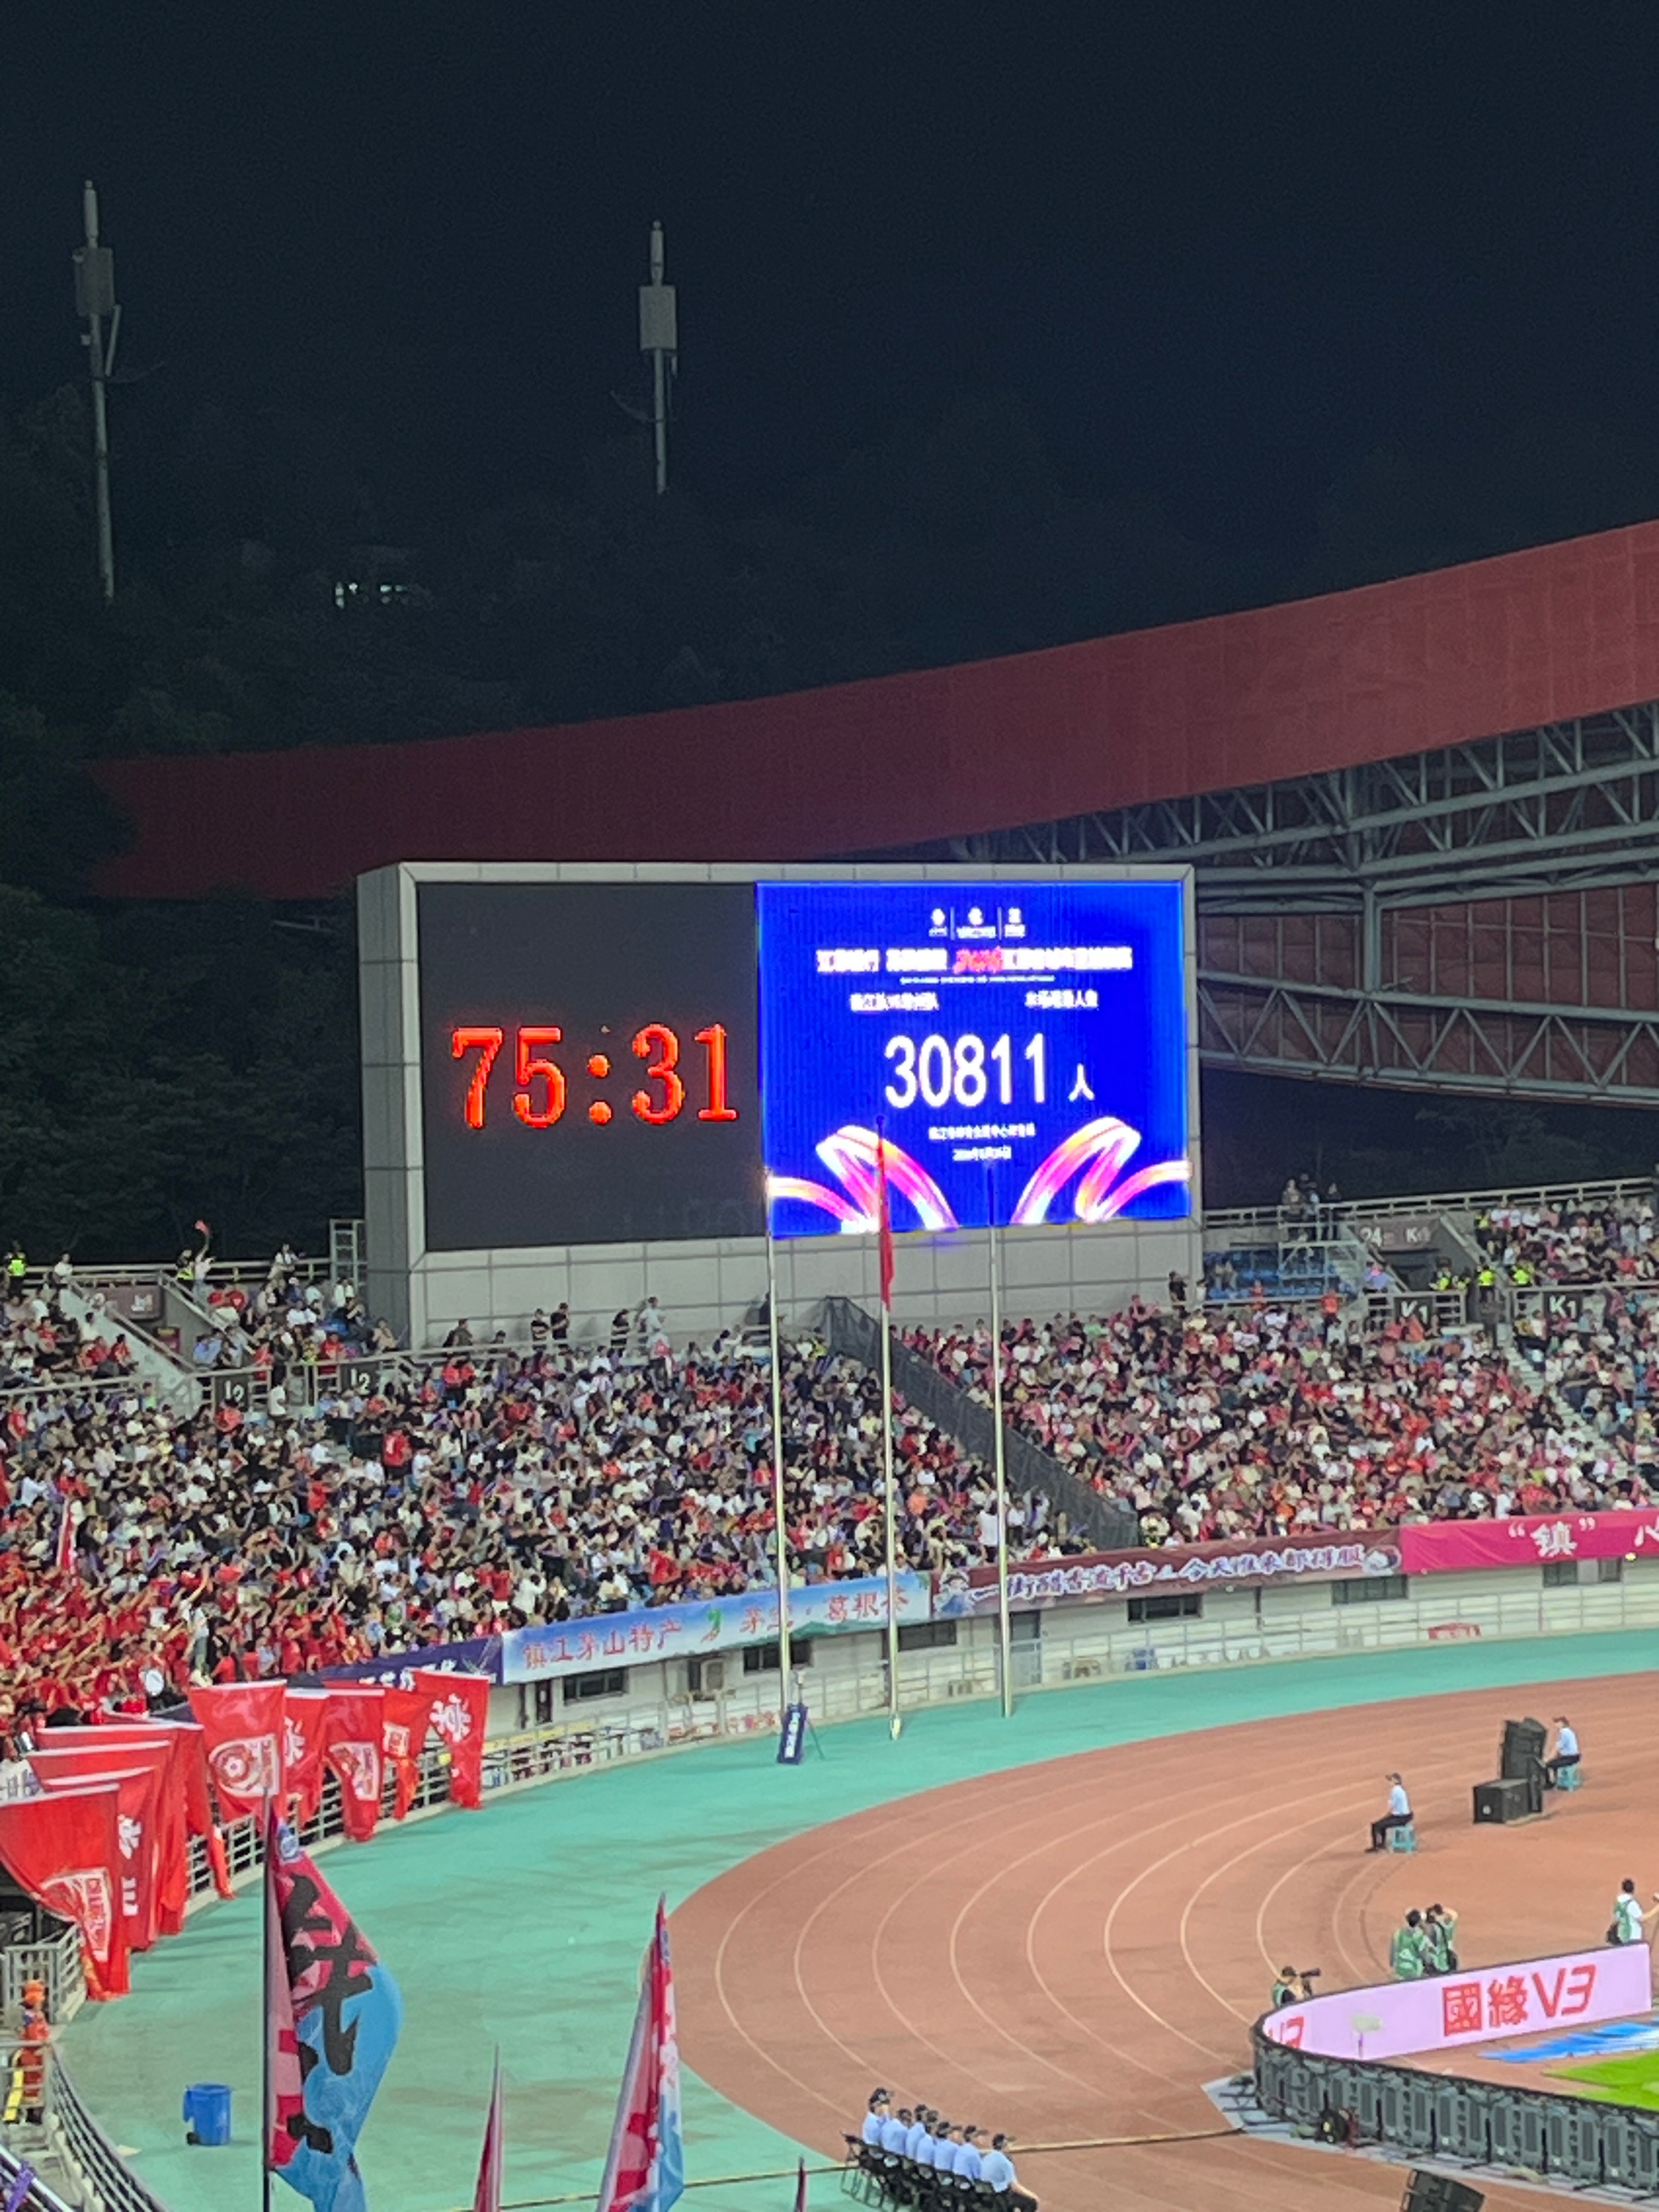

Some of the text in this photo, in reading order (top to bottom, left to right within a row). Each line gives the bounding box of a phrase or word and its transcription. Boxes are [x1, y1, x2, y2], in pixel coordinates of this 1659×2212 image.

[452, 1023, 738, 1129] 75:31
[884, 1033, 1094, 1109] 30811 人
[523, 1617, 681, 1669] 镇江茅山特产
